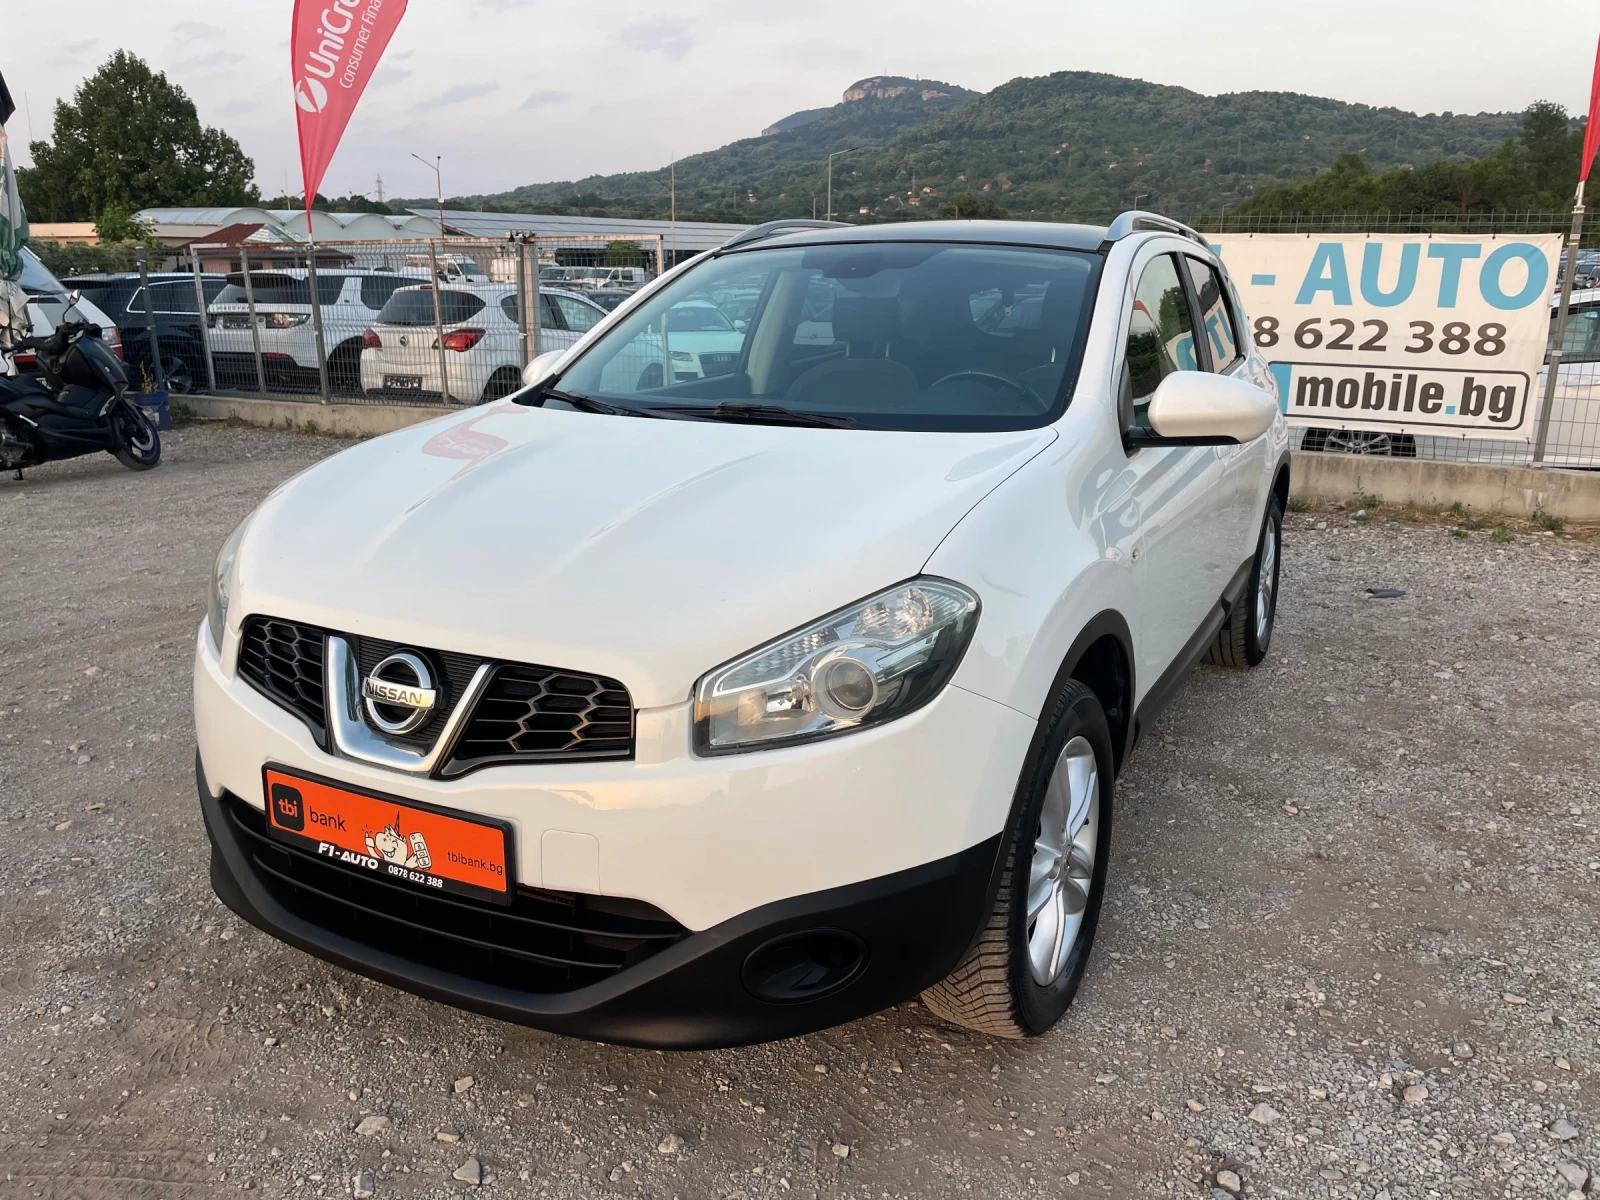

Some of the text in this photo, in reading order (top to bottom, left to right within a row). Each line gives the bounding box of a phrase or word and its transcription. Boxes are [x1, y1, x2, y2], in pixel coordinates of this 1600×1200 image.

[340, 24, 371, 89] Consumer
[1294, 242, 1549, 311] AUTO
[1293, 317, 1389, 352] 622
[1404, 320, 1507, 357] 388
[1295, 372, 1517, 423] mobile.bg
[365, 681, 423, 704] NISSAN
[278, 798, 347, 832] tbi bank
[318, 841, 379, 870] F1-AUTO
[446, 850, 503, 876] tbibank.bg
[388, 864, 443, 888] 0878 622 388
